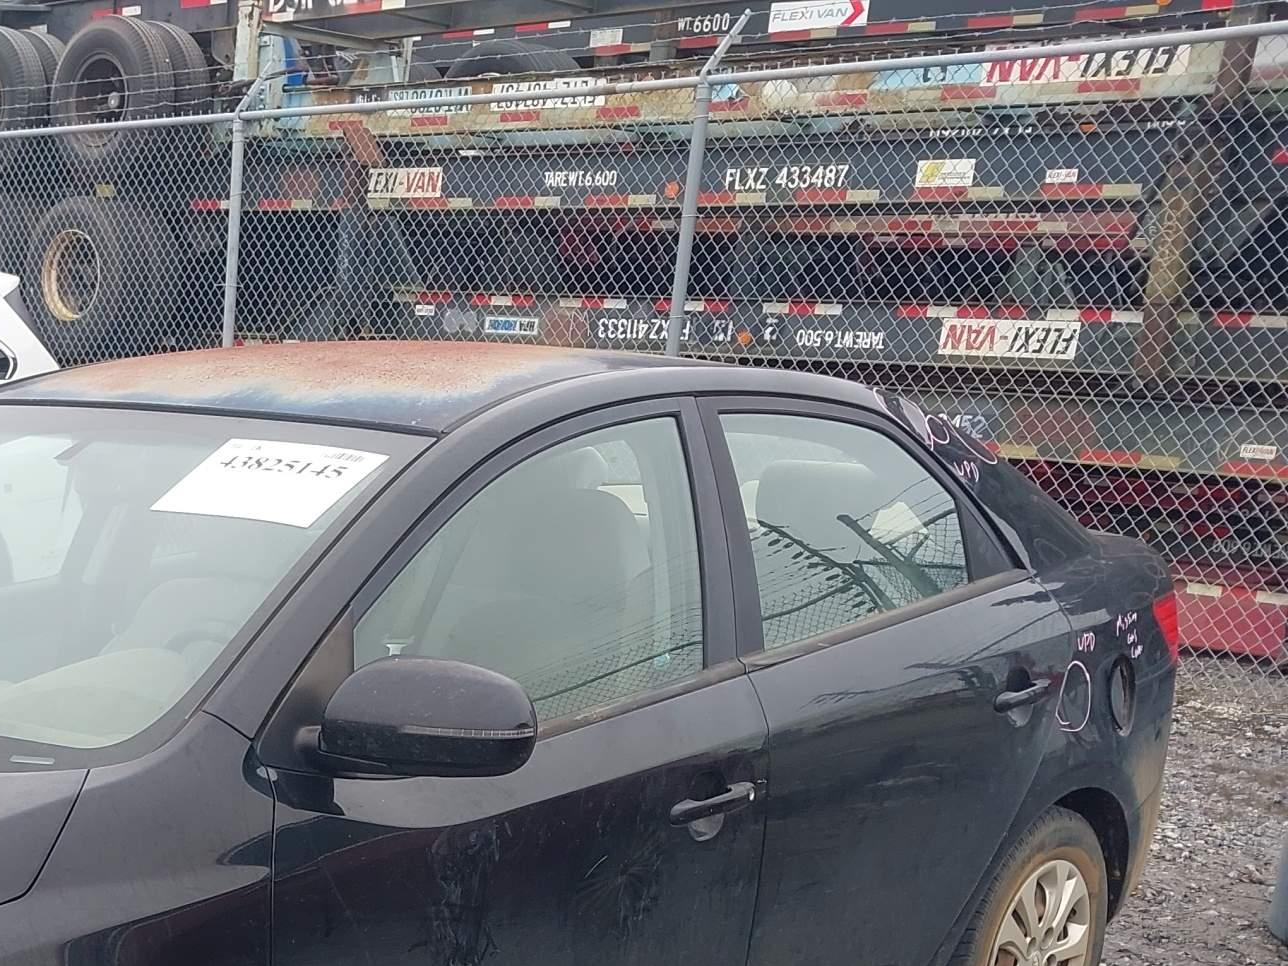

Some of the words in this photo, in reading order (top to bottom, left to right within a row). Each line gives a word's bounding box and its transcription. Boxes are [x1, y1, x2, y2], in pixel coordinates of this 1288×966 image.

[771, 9, 814, 24] FLEXI
[817, 7, 849, 19] VAN
[368, 169, 440, 194] LEXI-VAN
[725, 168, 768, 190] FLXZ
[775, 165, 849, 188] 433487
[650, 319, 691, 341] FXZ
[942, 323, 1077, 355] FLEXI-VAN
[220, 454, 349, 480] 43825145
